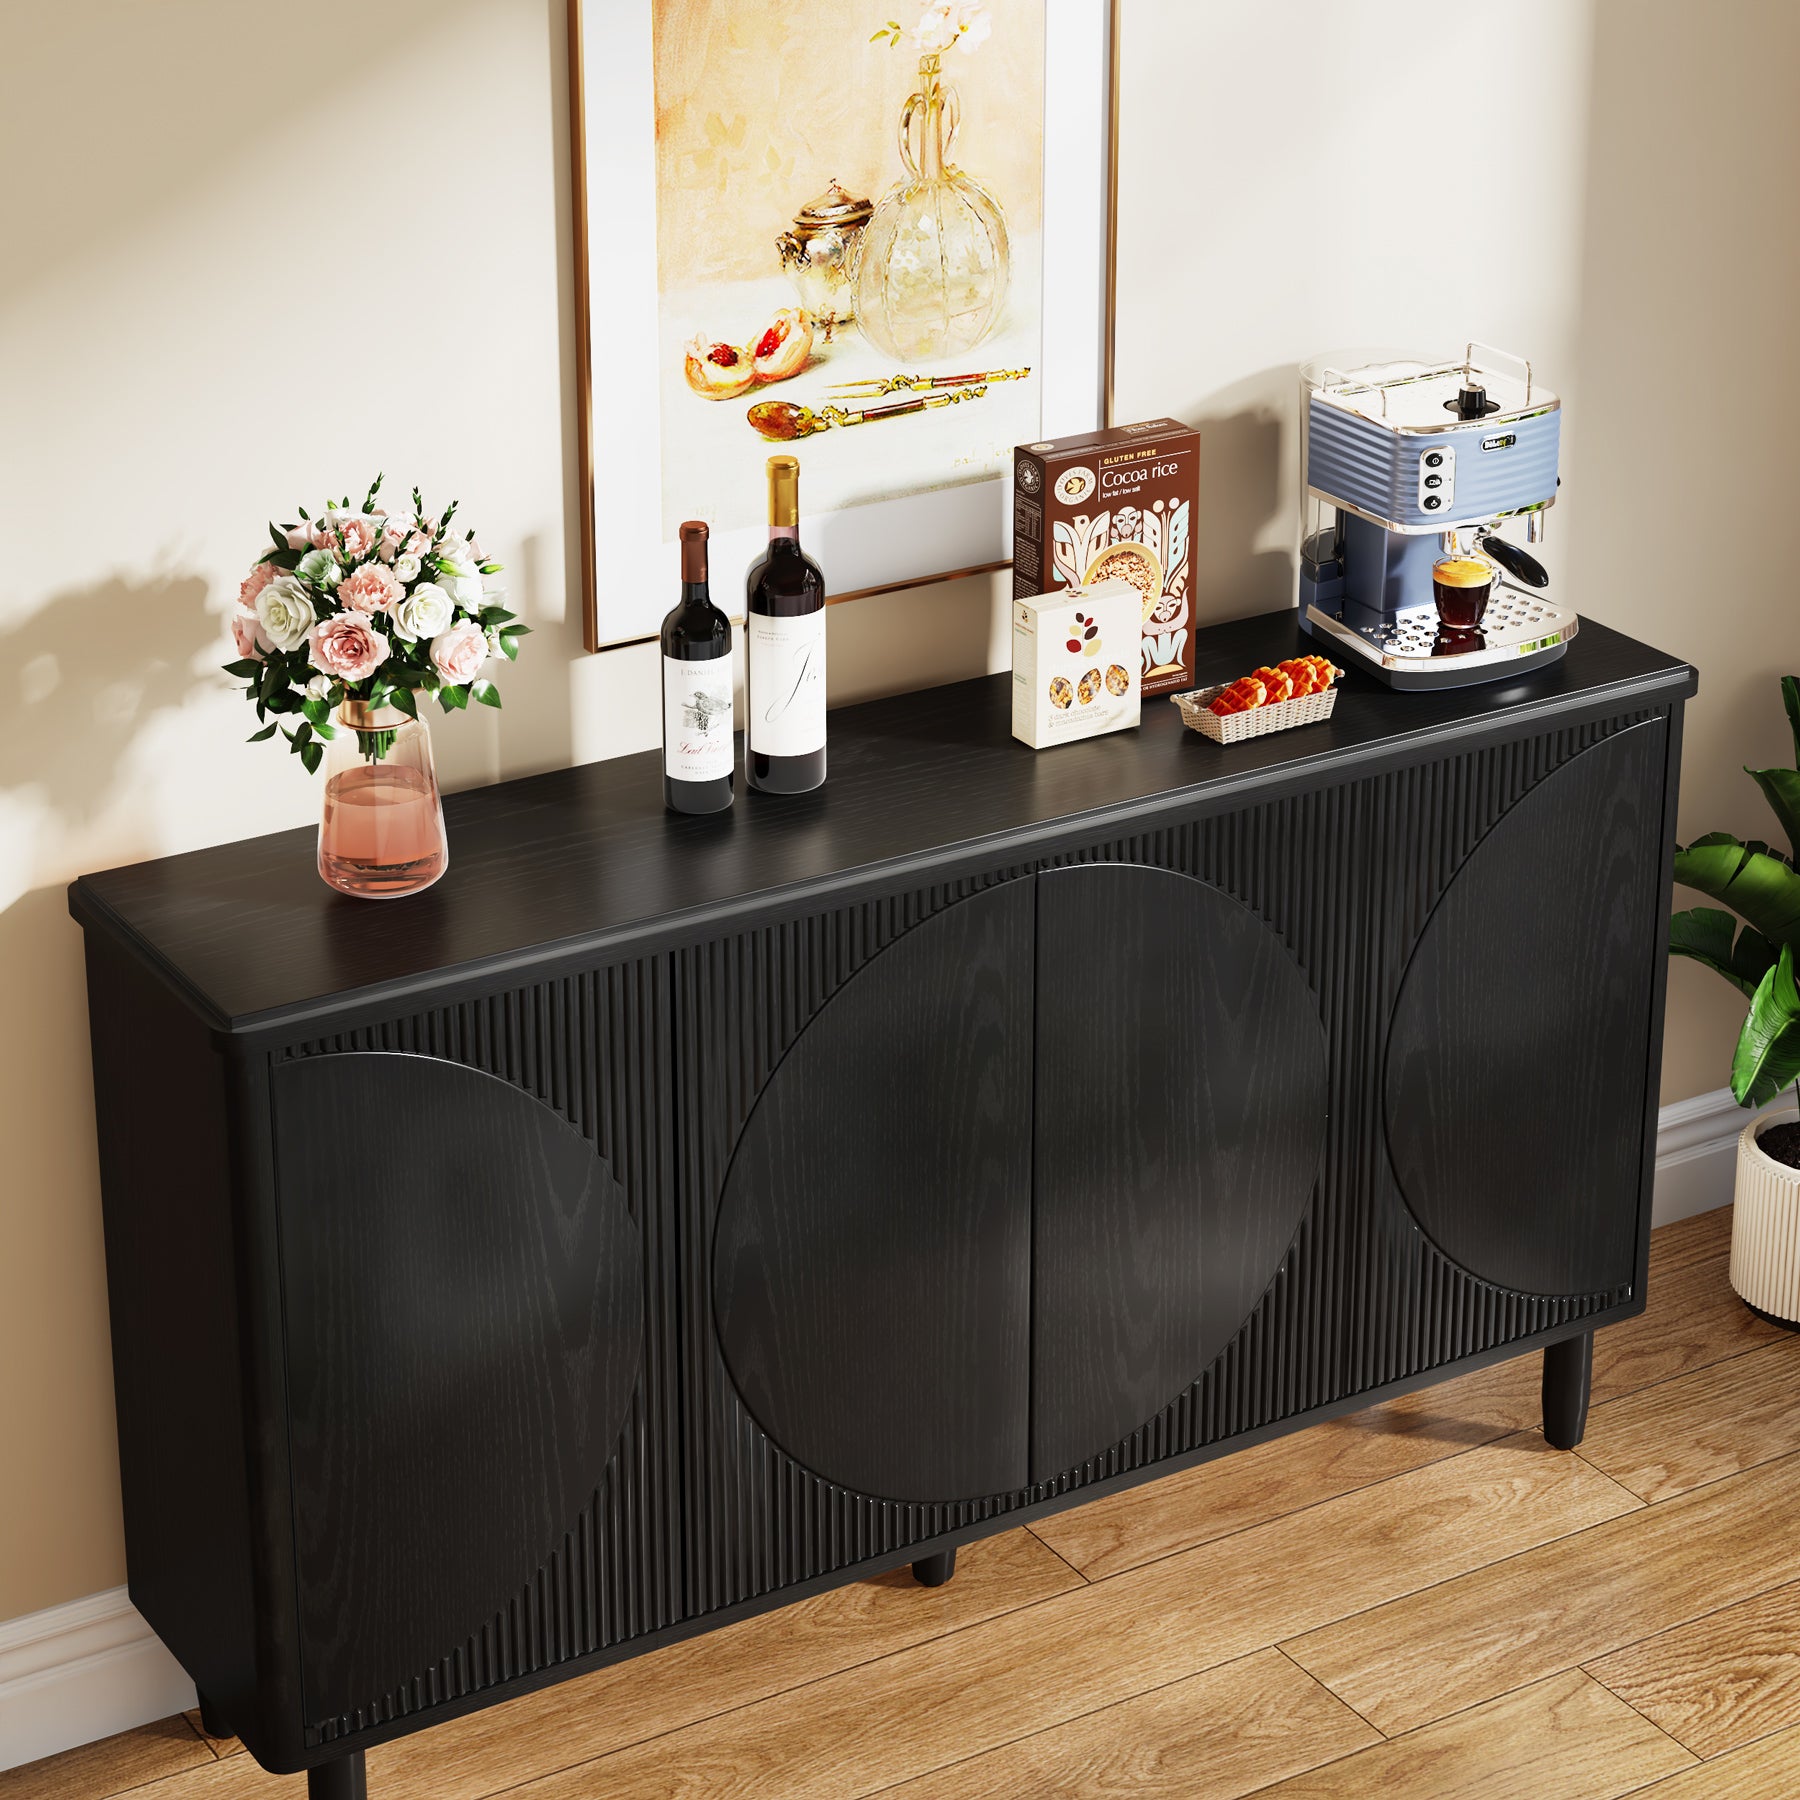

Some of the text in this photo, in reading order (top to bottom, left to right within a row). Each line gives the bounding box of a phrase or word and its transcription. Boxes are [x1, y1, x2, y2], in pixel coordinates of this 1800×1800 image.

[1104, 449, 1157, 465] GLUTEN FREE
[1102, 462, 1178, 488] Cocoa rice
